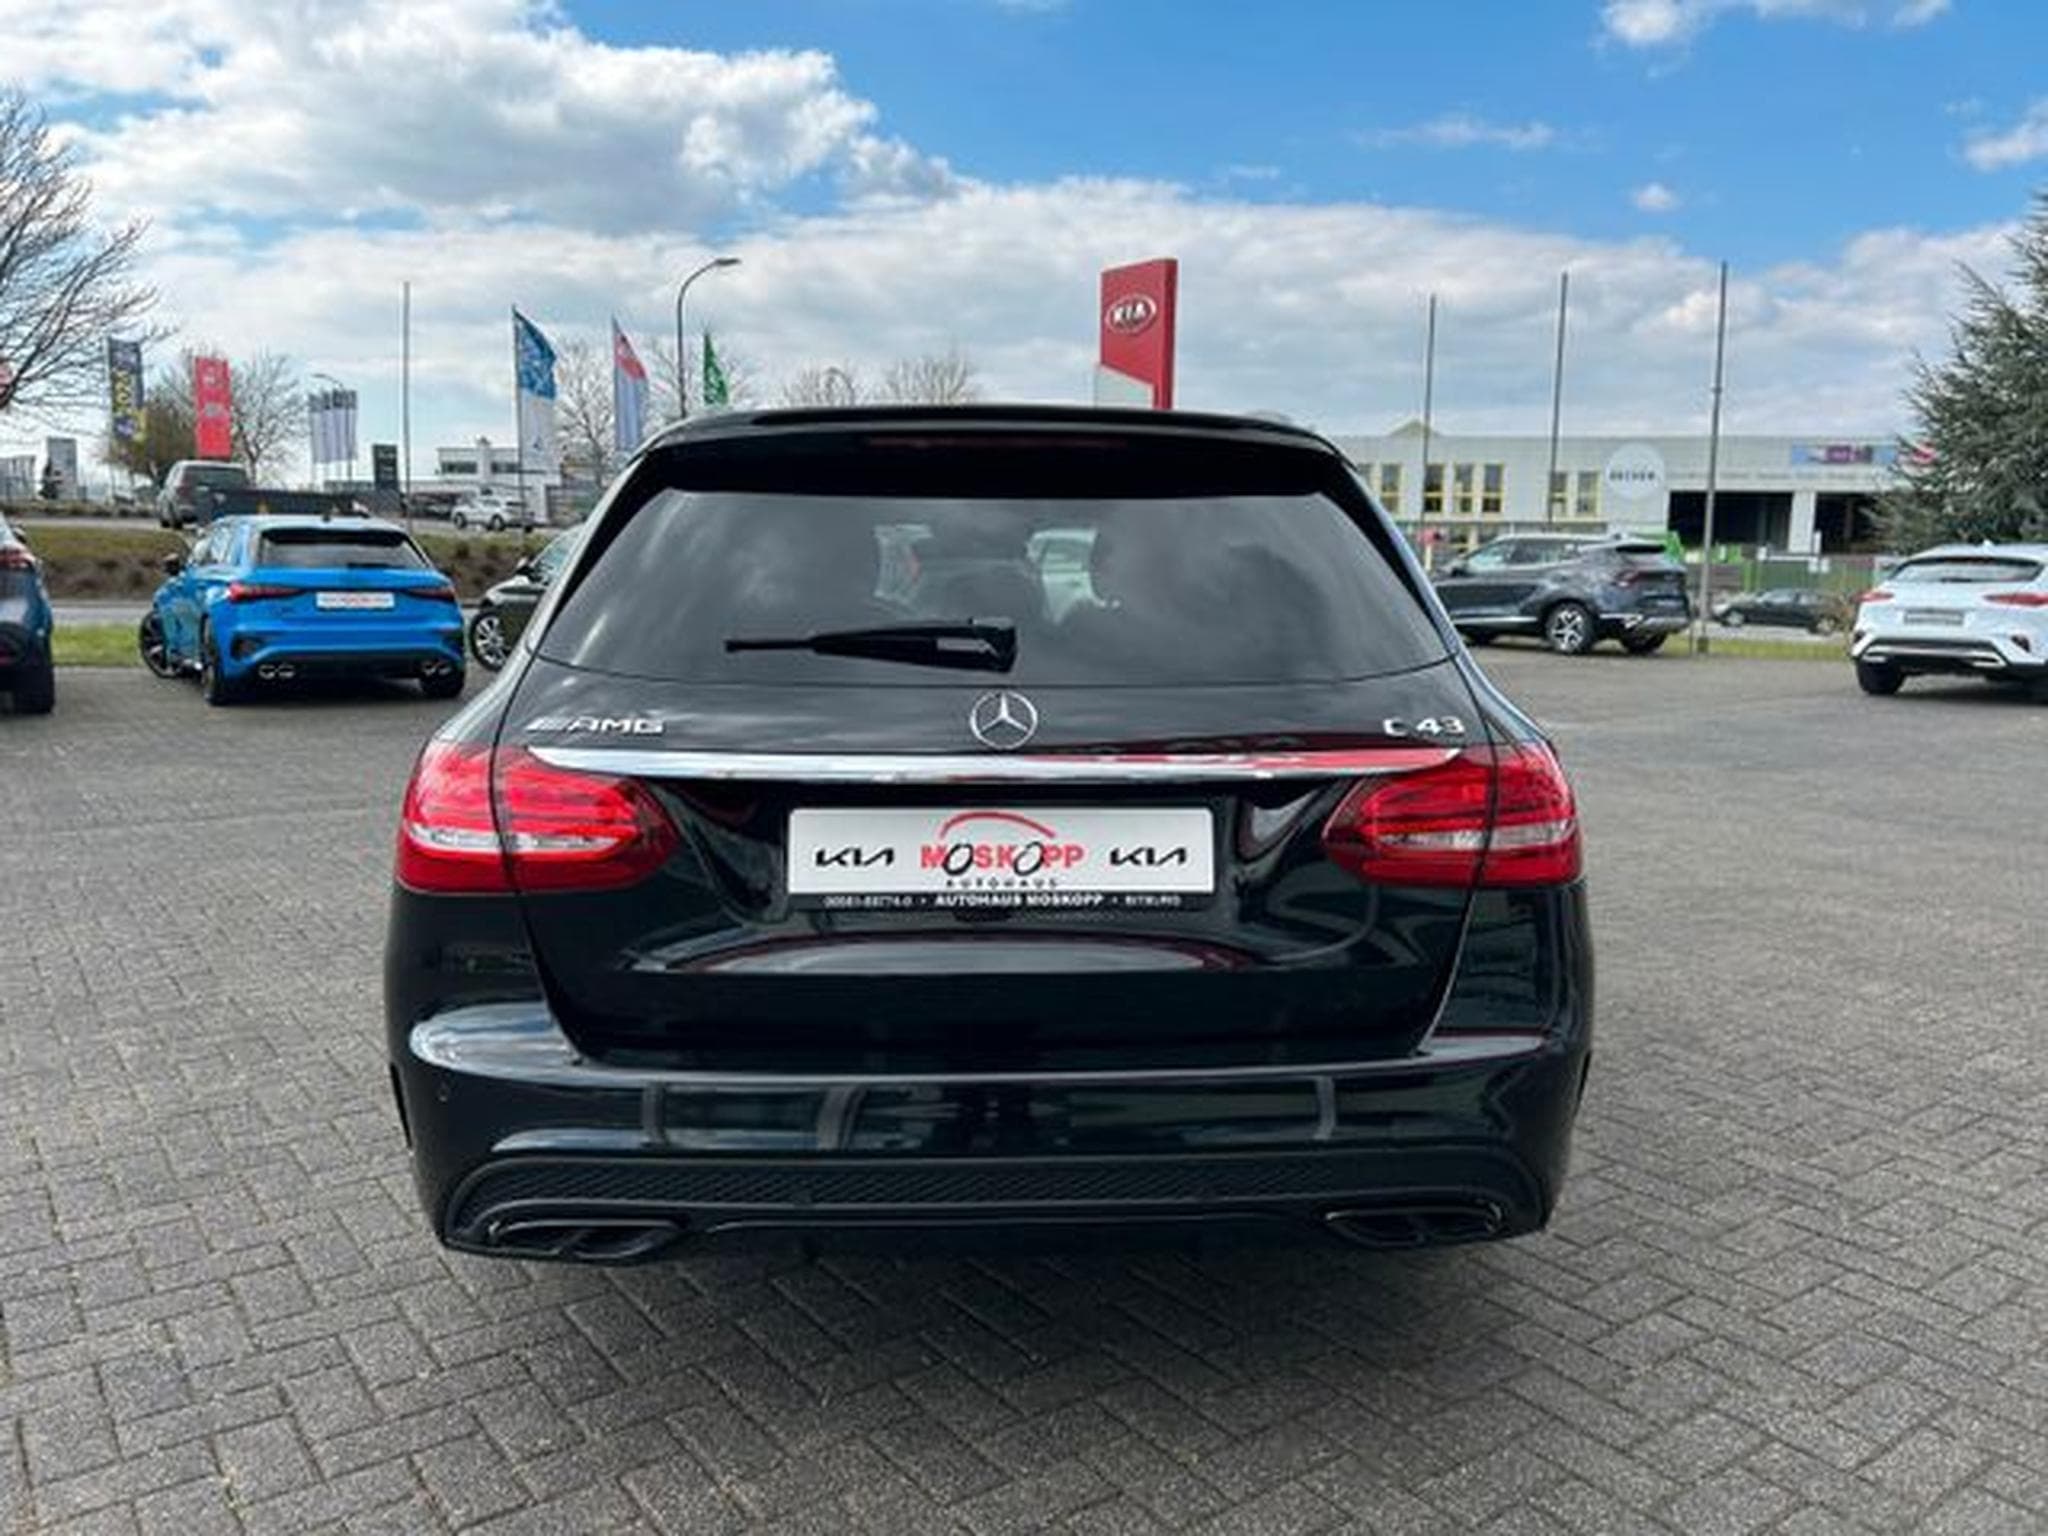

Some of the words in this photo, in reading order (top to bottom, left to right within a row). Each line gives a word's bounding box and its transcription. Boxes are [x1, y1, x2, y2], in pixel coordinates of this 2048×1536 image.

[1112, 301, 1147, 324] KIA
[567, 716, 665, 734] AMG
[1383, 718, 1408, 737] C
[1416, 716, 1465, 735] 43
[815, 846, 895, 867] KIA
[920, 841, 1084, 876] MOSKOPP
[1110, 846, 1188, 867] KIA
[946, 878, 1058, 888] AUTOHAUS
[934, 893, 1022, 907] AUTOHAUS
[1026, 893, 1104, 907] MOSKOPP
